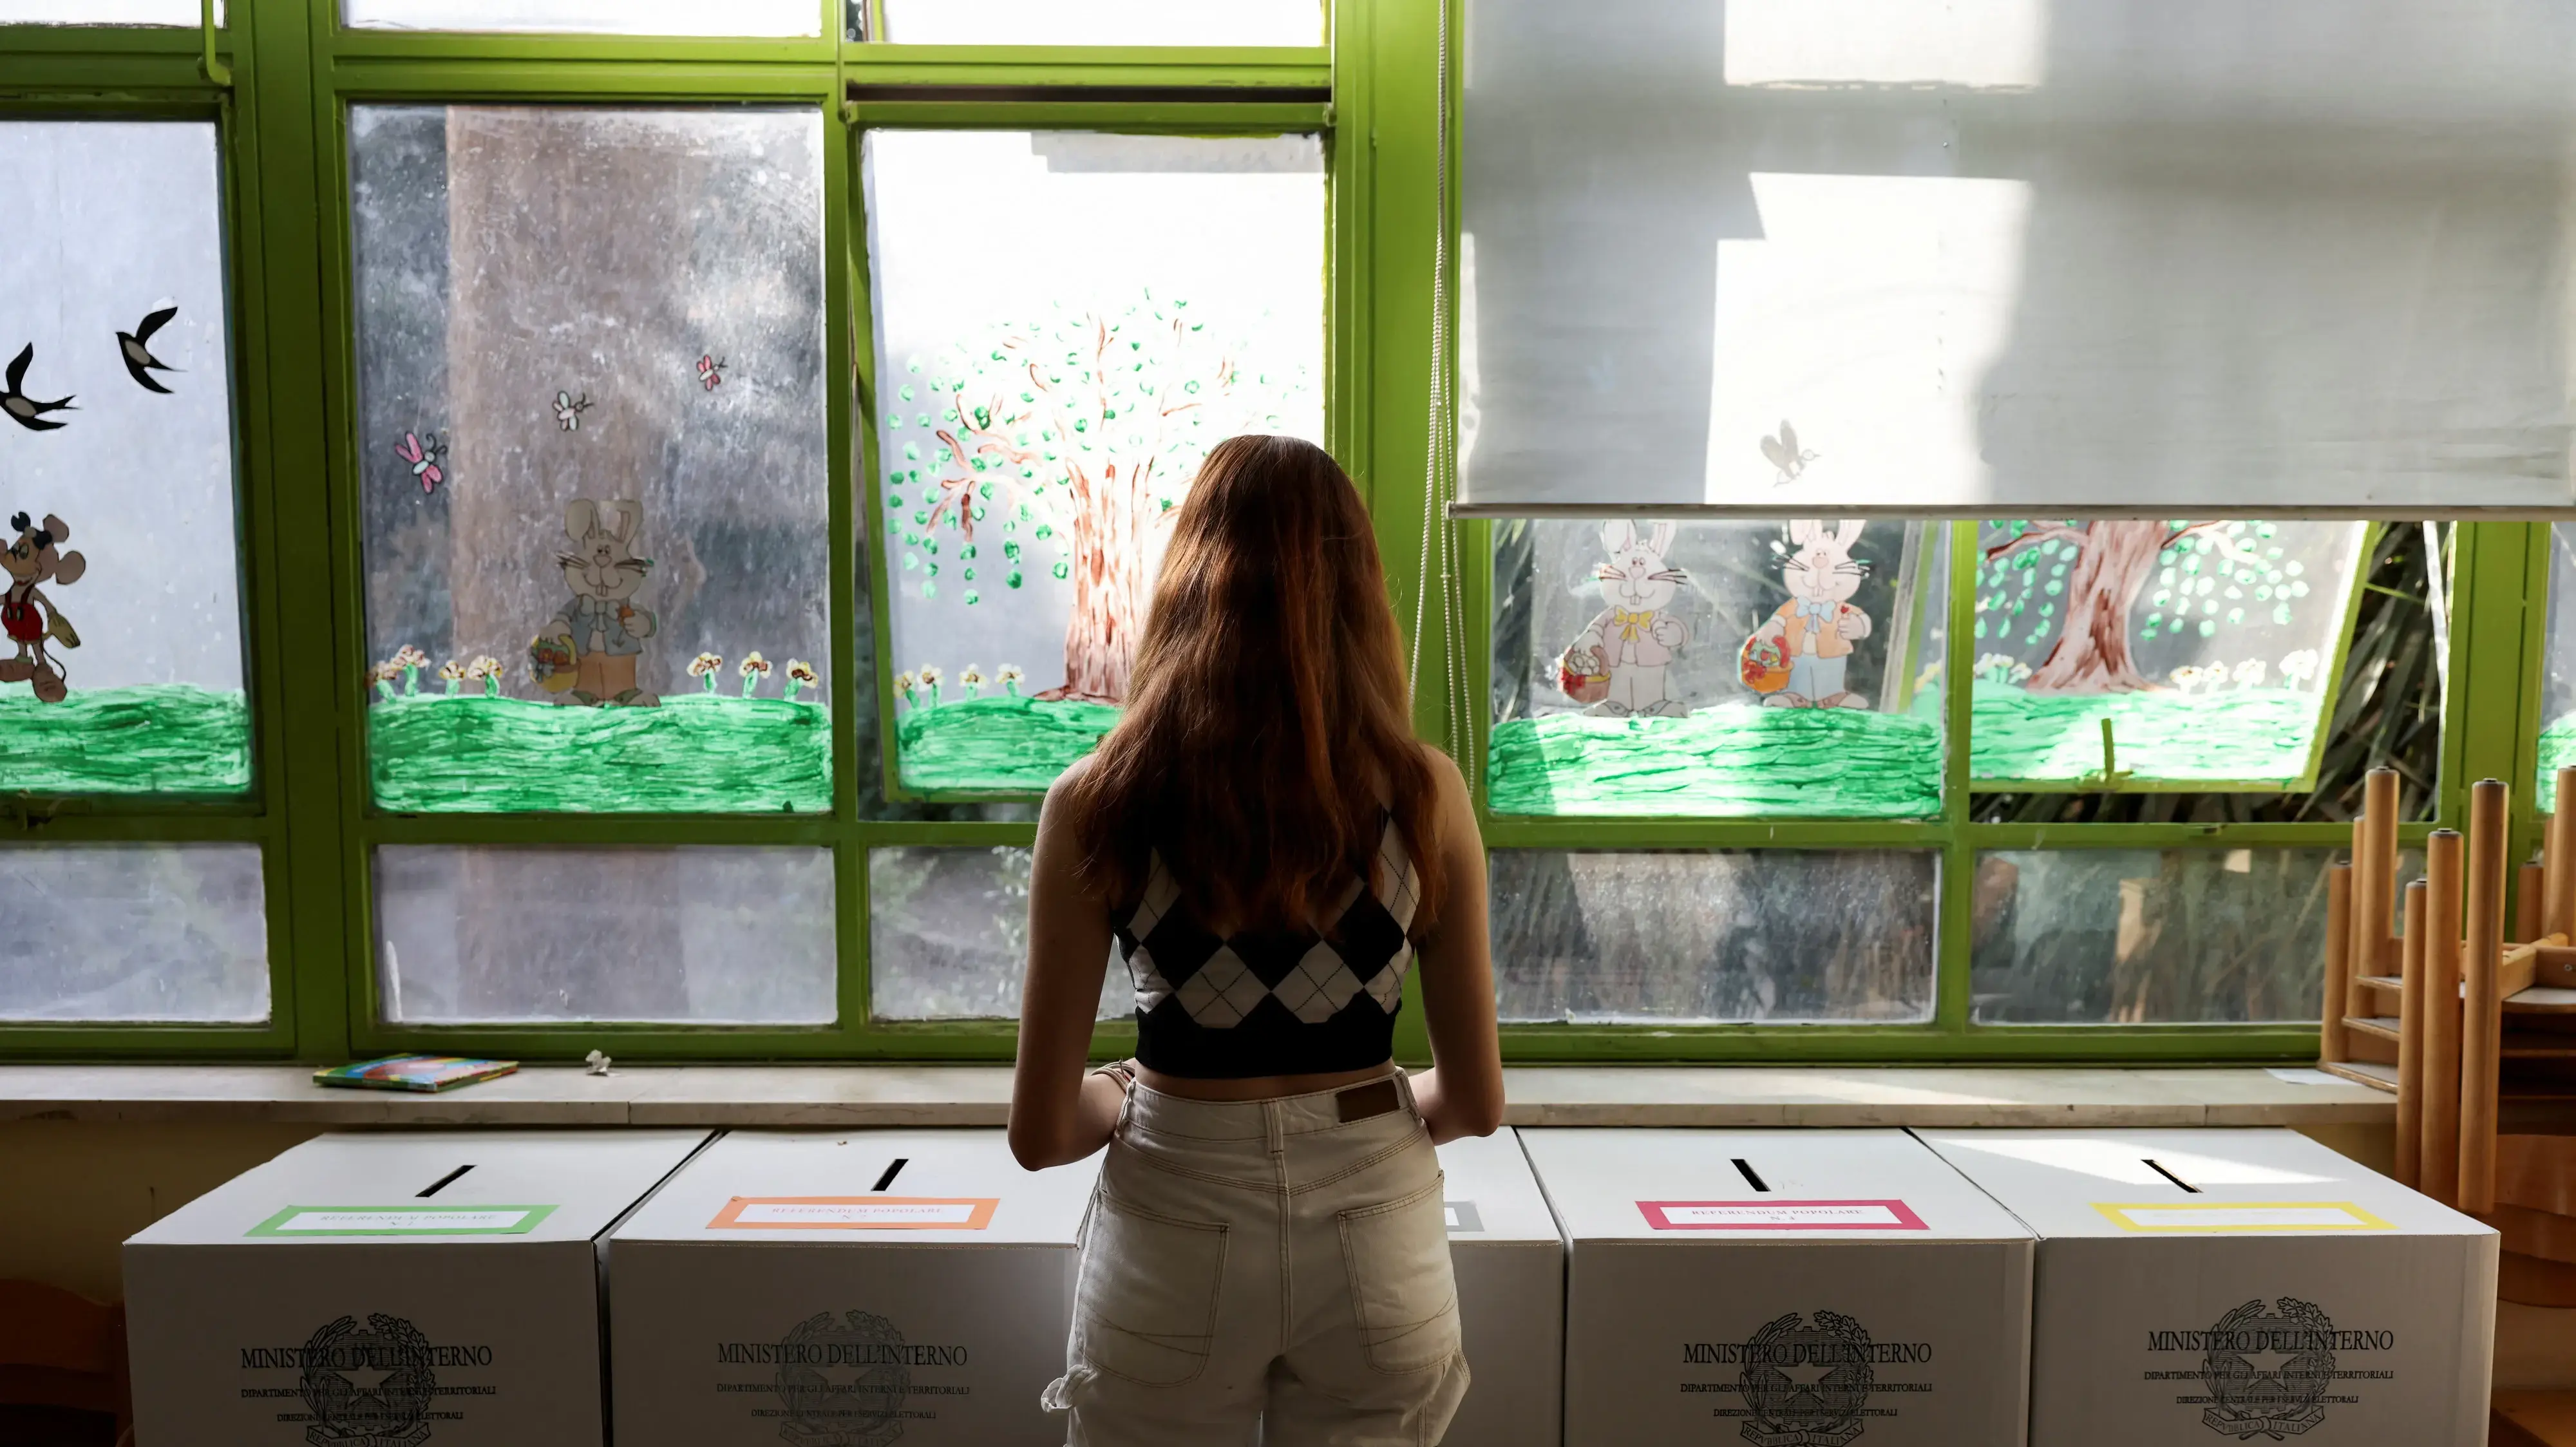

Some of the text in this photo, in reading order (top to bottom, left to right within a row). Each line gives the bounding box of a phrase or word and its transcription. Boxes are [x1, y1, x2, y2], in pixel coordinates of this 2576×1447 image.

[2147, 1330, 2394, 1351] MINISTERO DELL'INTERNO
[241, 1346, 492, 1368] MINISTERO DELLINTERNO
[717, 1343, 967, 1367] MINISTERO DELL'INTERNO
[1683, 1343, 1932, 1364] MINISTERO DELL'INTERNO
[2144, 1371, 2212, 1380] DIPARTIMENTO
[2214, 1371, 2231, 1379] PER
[2233, 1371, 2248, 1379] GLI
[2251, 1371, 2281, 1379] AFFARI
[2332, 1370, 2394, 1379] TERRITORIALI
[241, 1388, 311, 1397] DIPARTIMENTO
[351, 1388, 381, 1396] AFFARI
[433, 1386, 497, 1395] TERRITORIALI
[716, 1383, 786, 1393] DIPARTIMENTO
[788, 1384, 806, 1393] PER
[808, 1385, 822, 1393] GLI
[825, 1385, 855, 1394] AFFARI
[860, 1385, 900, 1394] INTERNI
[907, 1386, 970, 1394] TERRITORIALI
[1680, 1383, 1750, 1392] DIPARTIMENTO
[1790, 1384, 1819, 1392] AFFARI
[1870, 1383, 1933, 1392] TERRITORIALI
[419, 1412, 464, 1420] LETTORALI
[1852, 1408, 1898, 1417] ELETTORALI
[2273, 1413, 2321, 1432] ITALIANA
[1812, 1426, 1861, 1445] ITALIANA
